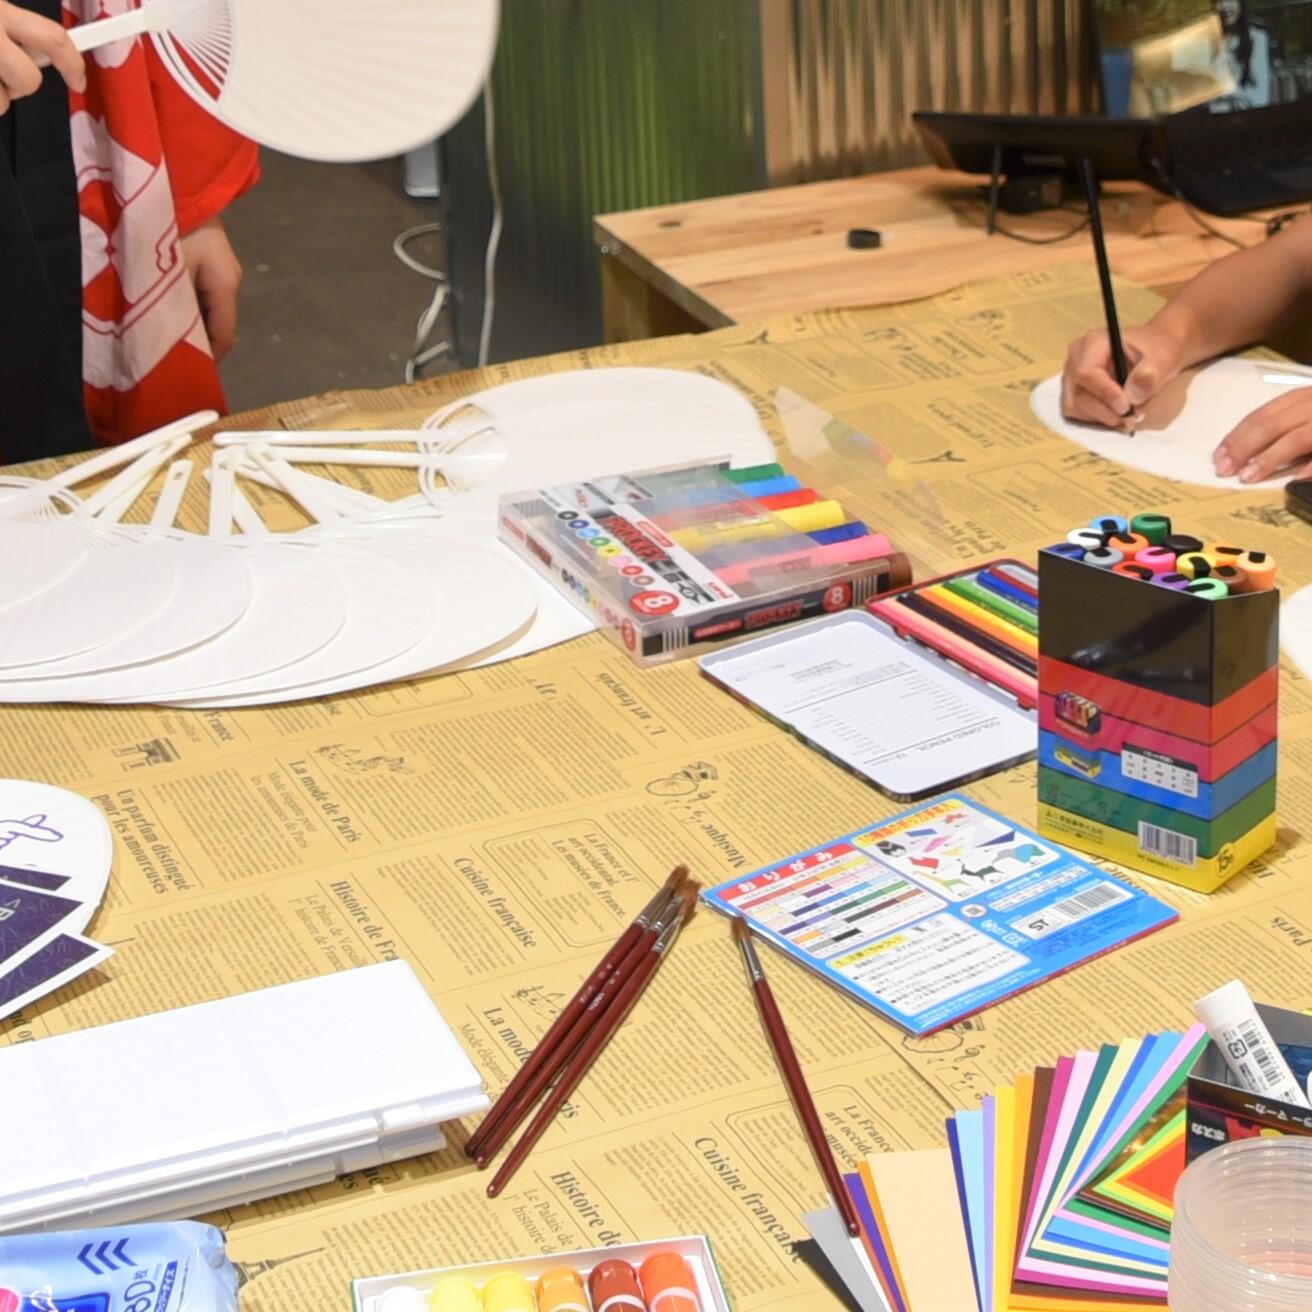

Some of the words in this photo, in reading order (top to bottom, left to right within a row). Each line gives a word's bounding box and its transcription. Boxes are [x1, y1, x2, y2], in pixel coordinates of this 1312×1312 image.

[830, 584, 844, 605] 8
[117, 789, 135, 805] Un
[289, 760, 307, 776] La
[301, 775, 329, 802] mode
[322, 802, 340, 815] de
[332, 815, 362, 843] Paris
[121, 806, 159, 844] parfum
[91, 794, 120, 816] pour
[112, 818, 129, 833] les
[122, 835, 169, 894] amoureuses
[551, 840, 568, 854] Les
[563, 850, 592, 881] musées
[594, 843, 622, 872] France
[702, 823, 750, 869] Musique
[151, 843, 196, 890] distingué
[739, 849, 836, 894] おりがみ
[329, 880, 370, 924] Histoire
[363, 923, 383, 939] de
[453, 857, 494, 897] Cuisine
[488, 897, 537, 948] française
[1027, 919, 1050, 933] ST
[1269, 915, 1312, 948] Paris
[483, 1007, 505, 1027] La
[825, 1111, 841, 1125] art
[843, 1104, 857, 1120] La
[1243, 1102, 1288, 1122] マーカー
[1190, 1122, 1226, 1141] ポスカ
[694, 1137, 746, 1192] Cuisine
[551, 1170, 605, 1228] Histoire
[537, 1201, 563, 1235] Palais
